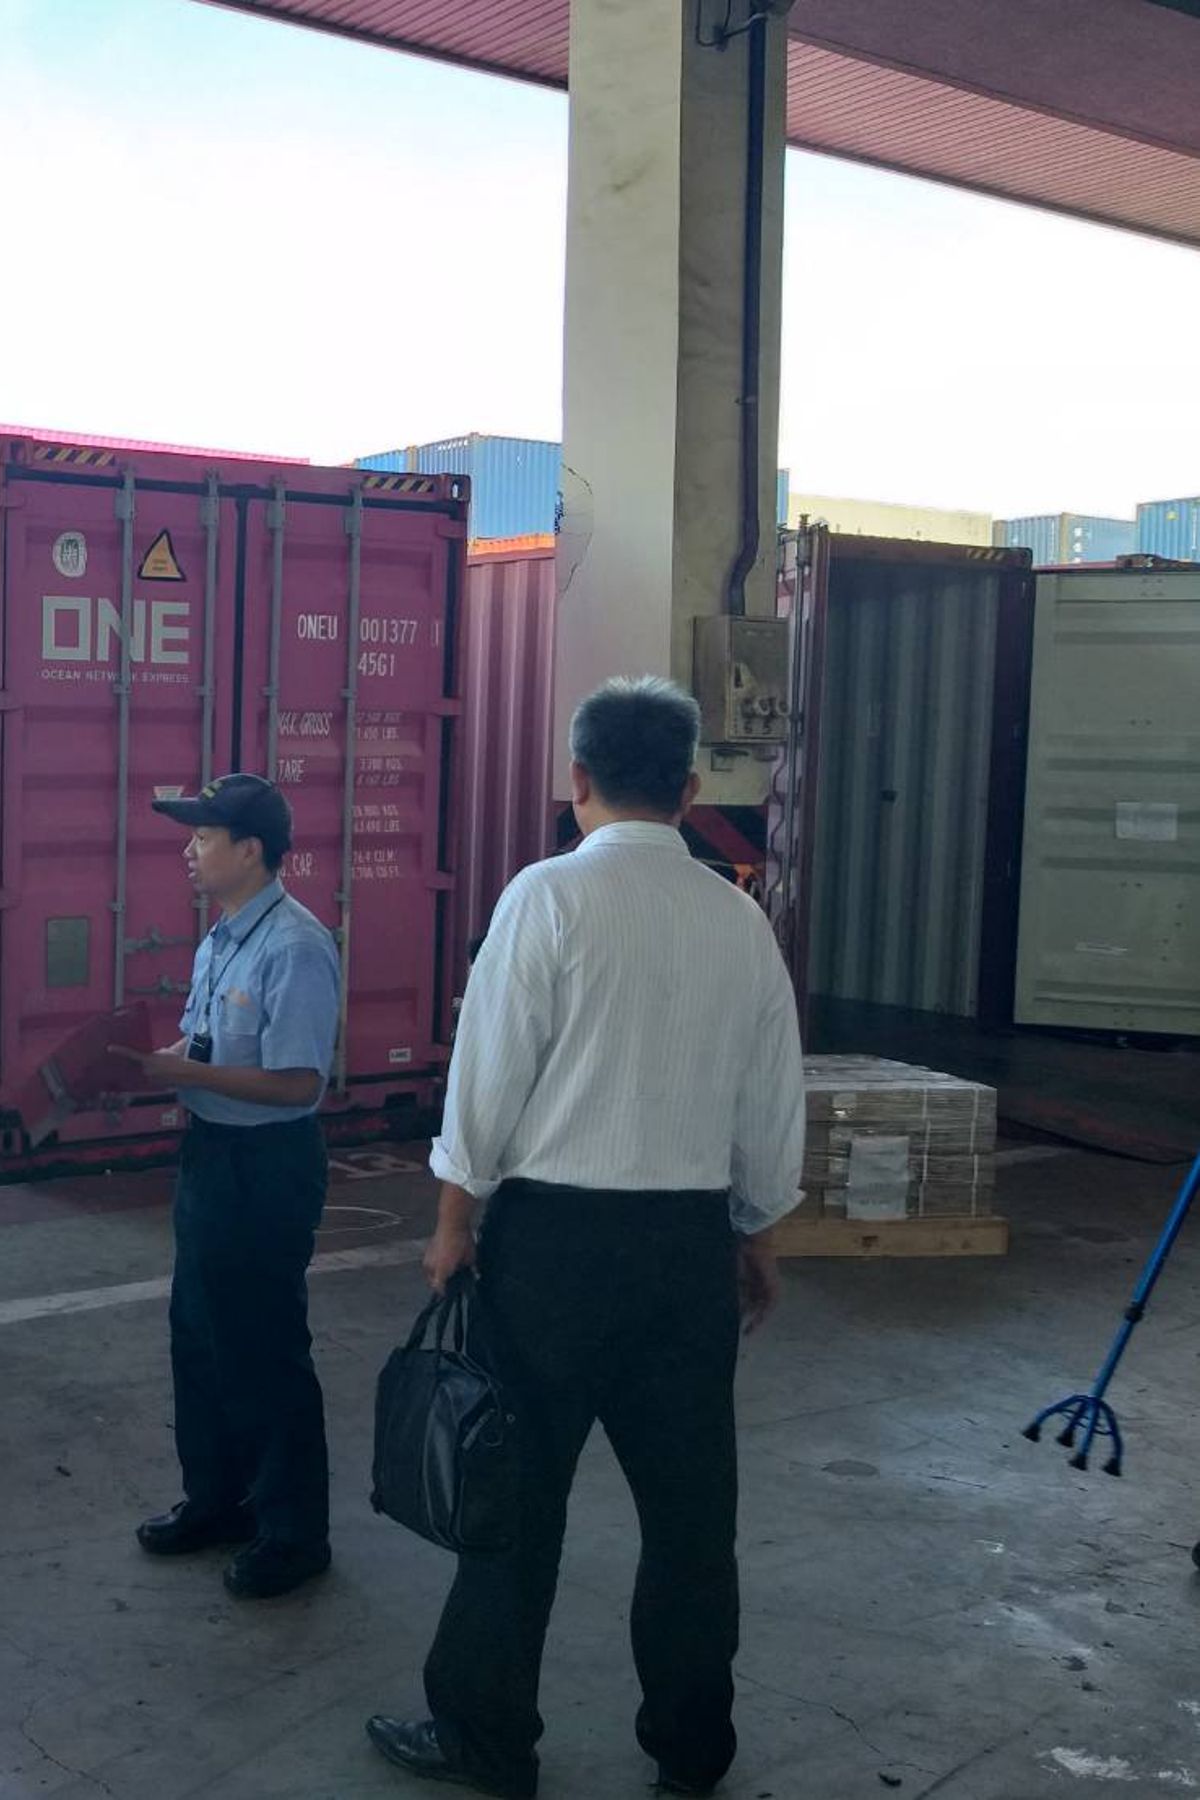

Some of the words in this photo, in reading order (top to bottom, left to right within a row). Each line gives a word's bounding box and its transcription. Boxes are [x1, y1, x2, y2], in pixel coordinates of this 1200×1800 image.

[42, 595, 189, 664] ONE
[298, 614, 338, 640] ONEU
[360, 618, 417, 645] 001377
[41, 669, 81, 680] OCEAN
[358, 652, 395, 676] 45G1
